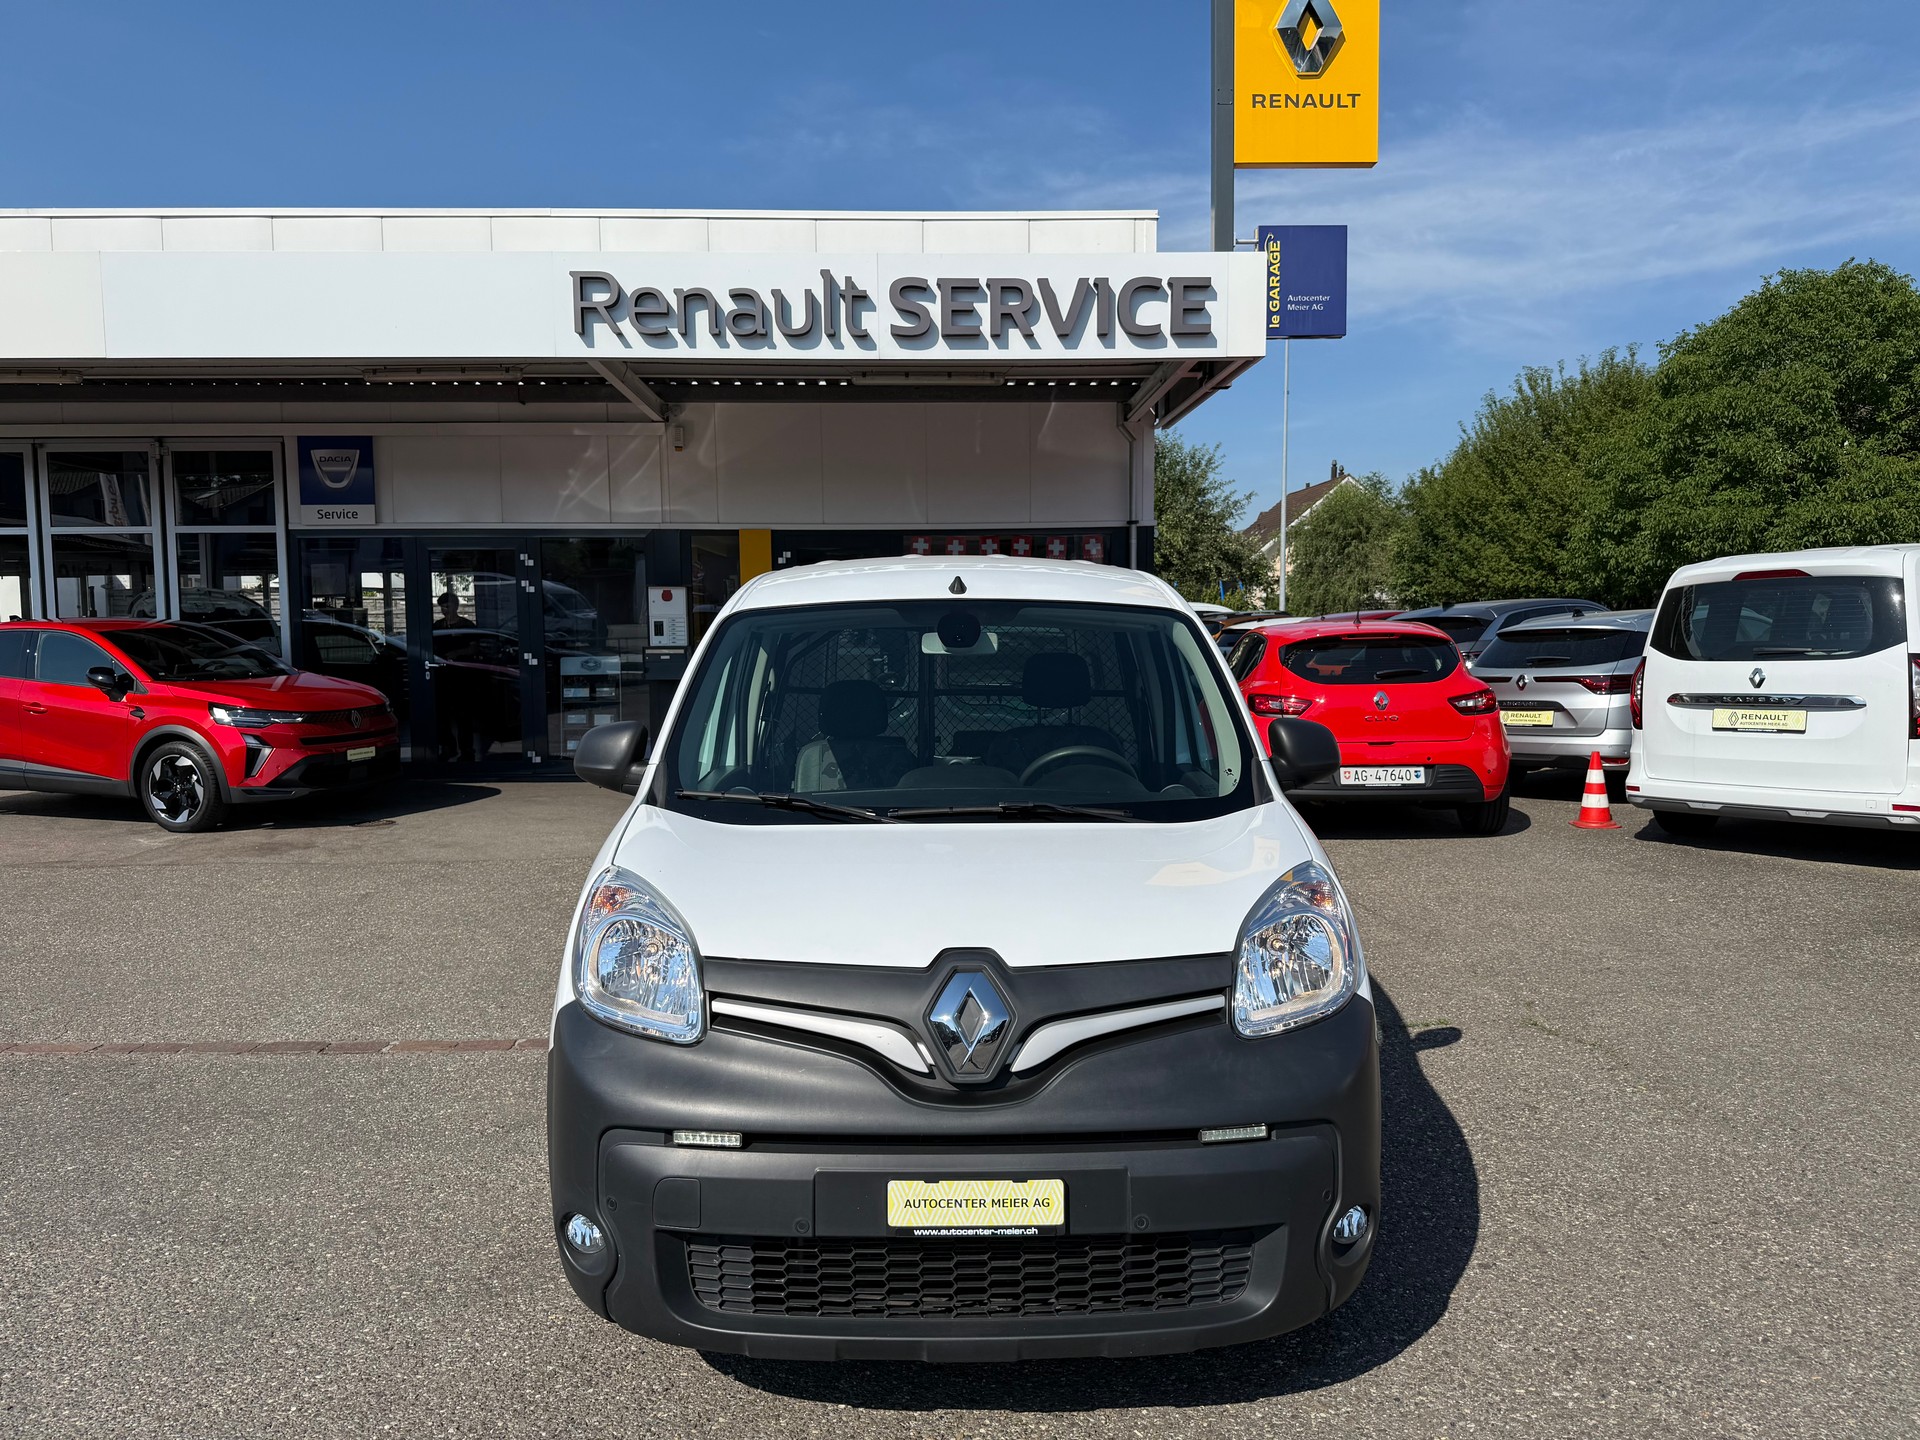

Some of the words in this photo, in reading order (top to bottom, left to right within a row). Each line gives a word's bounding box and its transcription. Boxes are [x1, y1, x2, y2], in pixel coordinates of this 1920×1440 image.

[1251, 93, 1361, 109] RENAULT
[1269, 240, 1280, 312] GARAGE
[569, 269, 868, 337] Renault
[888, 276, 1212, 338] SERVICE
[1287, 294, 1330, 302] Autocenter
[1287, 303, 1310, 311] Meier
[1311, 303, 1324, 311] AG
[1269, 315, 1280, 328] le
[317, 508, 358, 519] Service
[1364, 714, 1399, 722] CLIO
[1741, 713, 1788, 721] RENAULT
[904, 1198, 987, 1209] AUTOCENTER
[991, 1198, 1029, 1208] MEIER
[1033, 1198, 1050, 1208] AG
[914, 1227, 1038, 1236] www.autocenter-meier.ch
